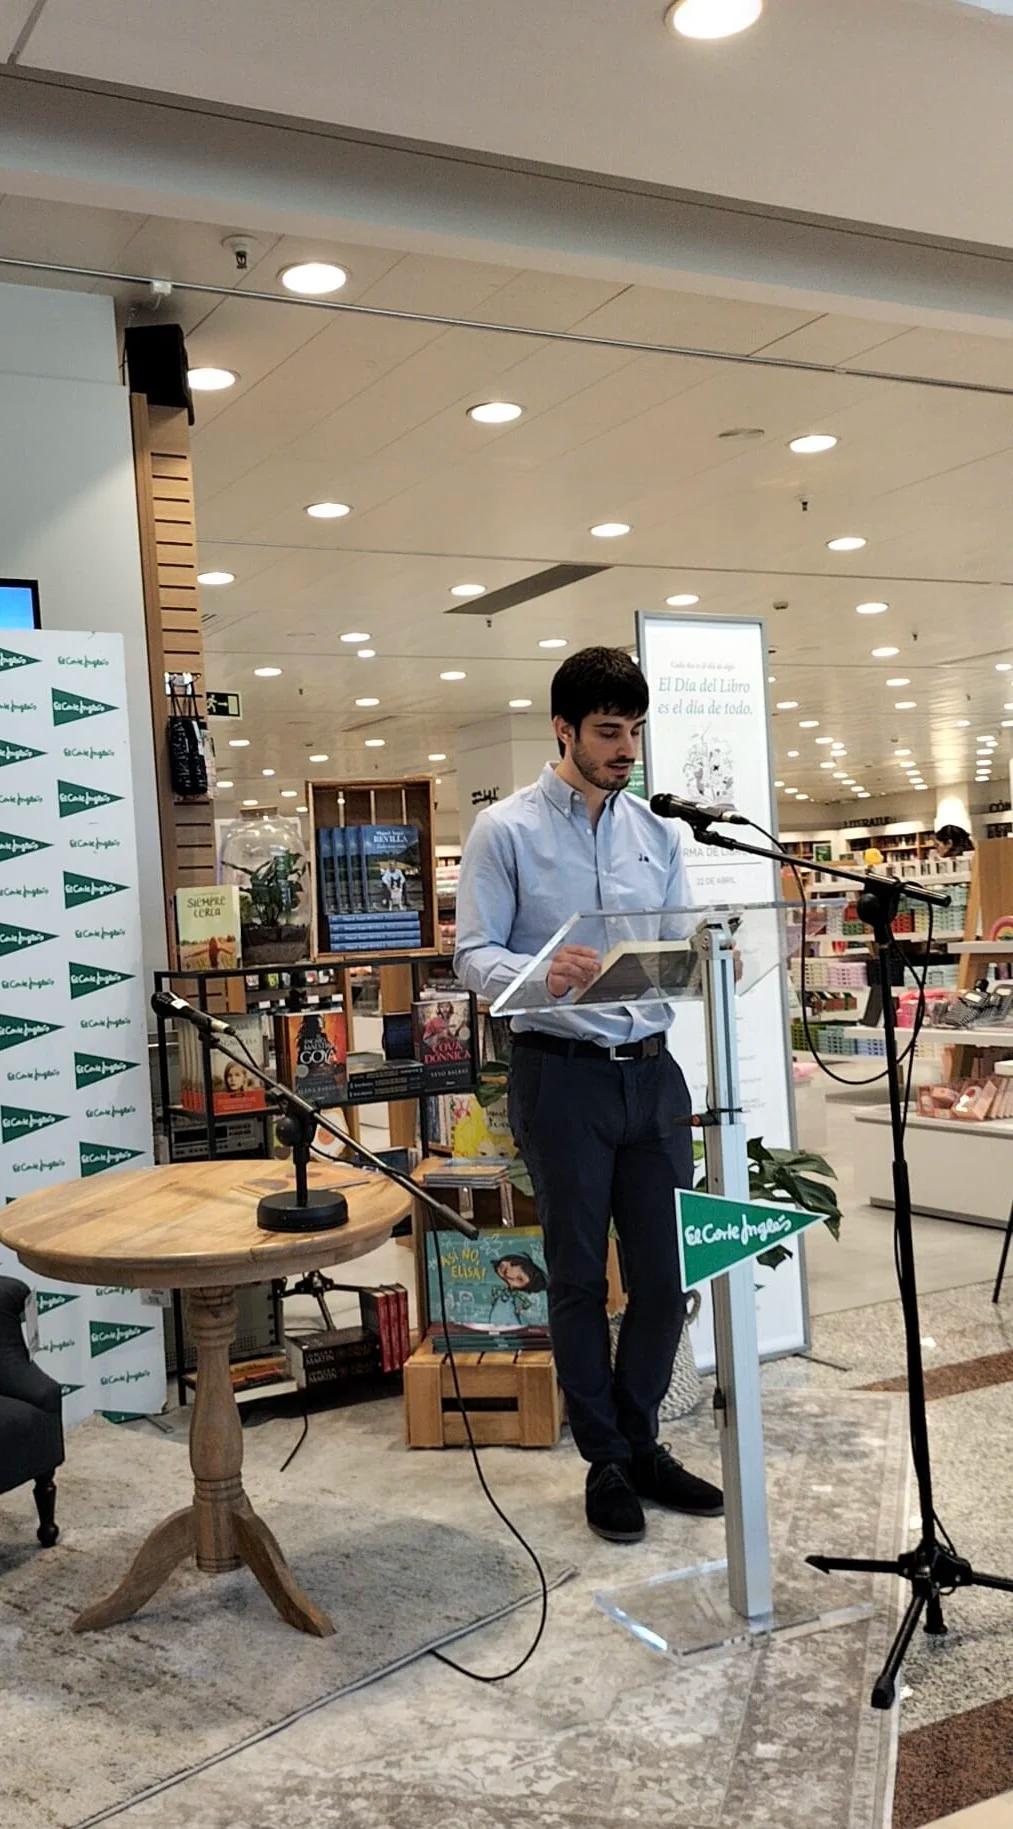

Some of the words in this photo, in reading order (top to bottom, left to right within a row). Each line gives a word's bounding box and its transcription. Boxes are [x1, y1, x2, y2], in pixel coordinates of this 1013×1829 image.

[659, 677, 671, 691] El
[674, 677, 696, 692] Día
[699, 677, 717, 692] del
[720, 678, 750, 693] Libro
[657, 703, 669, 714] es
[672, 699, 683, 714] el
[686, 699, 704, 714] día
[708, 699, 721, 714] de
[724, 700, 753, 715] todo.
[373, 835, 408, 843] REVILLA
[683, 847, 704, 857] RMA
[706, 847, 719, 857] DE
[186, 896, 226, 908] SIEMPRE
[432, 1040, 464, 1053] COVA
[300, 1048, 338, 1065] GOYA
[424, 1050, 471, 1065] DONNICA
[684, 1225, 702, 1246] El
[702, 1223, 740, 1243] Corte
[740, 1213, 792, 1246] Inglés
[452, 1264, 486, 1281] ELISA!
